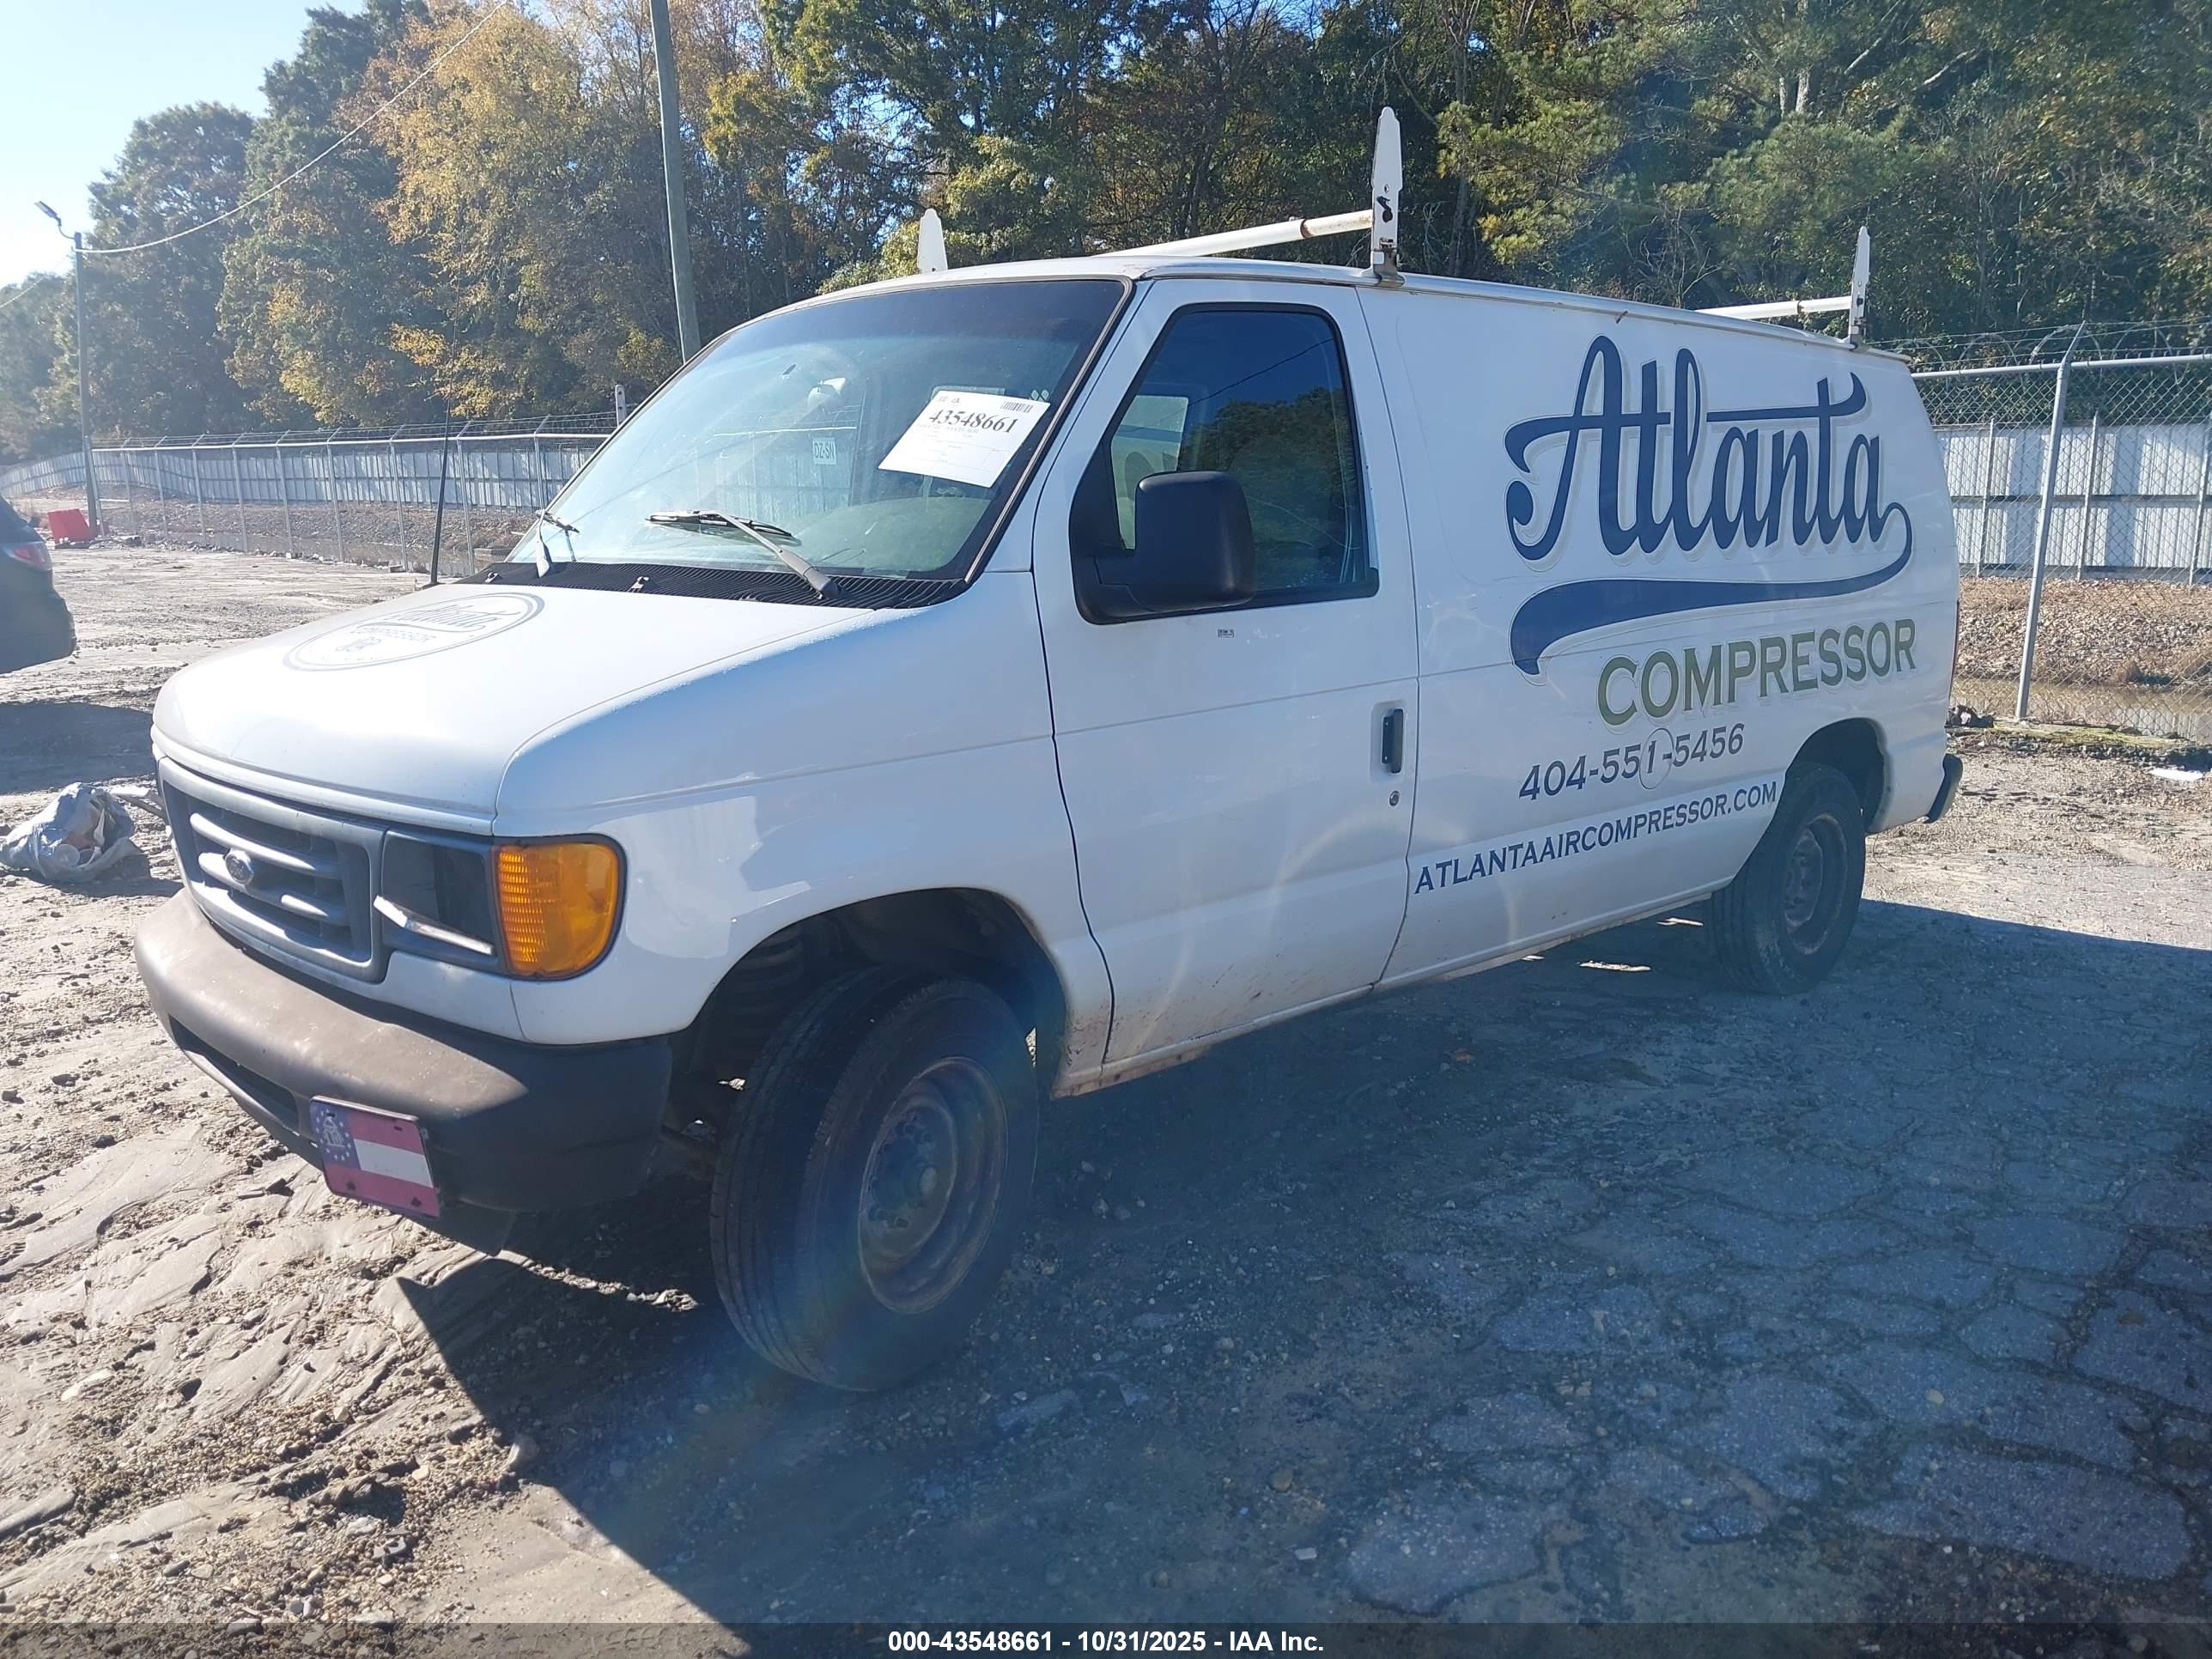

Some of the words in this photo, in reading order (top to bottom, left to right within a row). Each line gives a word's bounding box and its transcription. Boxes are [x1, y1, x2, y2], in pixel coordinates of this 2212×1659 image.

[929, 409, 1018, 434] 43548661
[1504, 335, 1896, 562] Atlanta
[1597, 618, 1916, 726] COMPRESSOR
[1519, 723, 1744, 800] 404-551-5456
[1414, 781, 1777, 894] ATLANTAAIRCOMPRESSOR.COM
